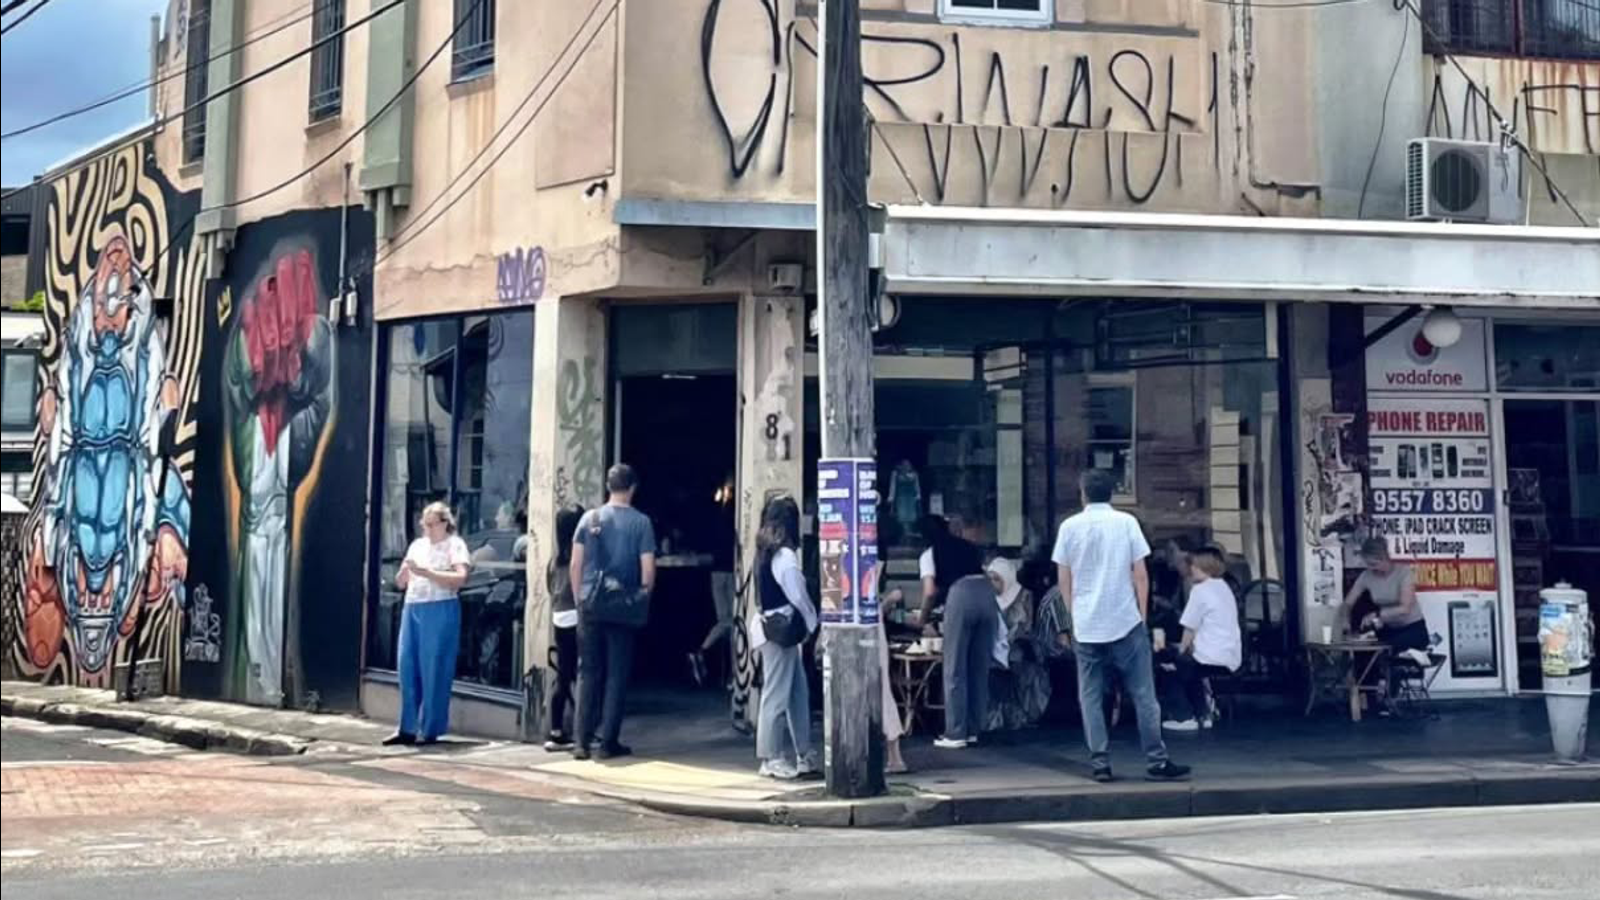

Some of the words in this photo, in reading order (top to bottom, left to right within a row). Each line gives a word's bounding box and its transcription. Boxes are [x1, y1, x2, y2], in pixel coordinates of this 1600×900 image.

[1385, 369, 1463, 385] vodafone
[1367, 411, 1422, 432] PHONE
[1426, 411, 1485, 432] REPAIR
[1374, 490, 1425, 512] 9557
[1432, 490, 1484, 512] 8360
[1426, 517, 1456, 534] CRACK
[1458, 517, 1492, 534] SCREEN
[1404, 537, 1429, 558] Liquid
[1431, 537, 1464, 558] Damage
